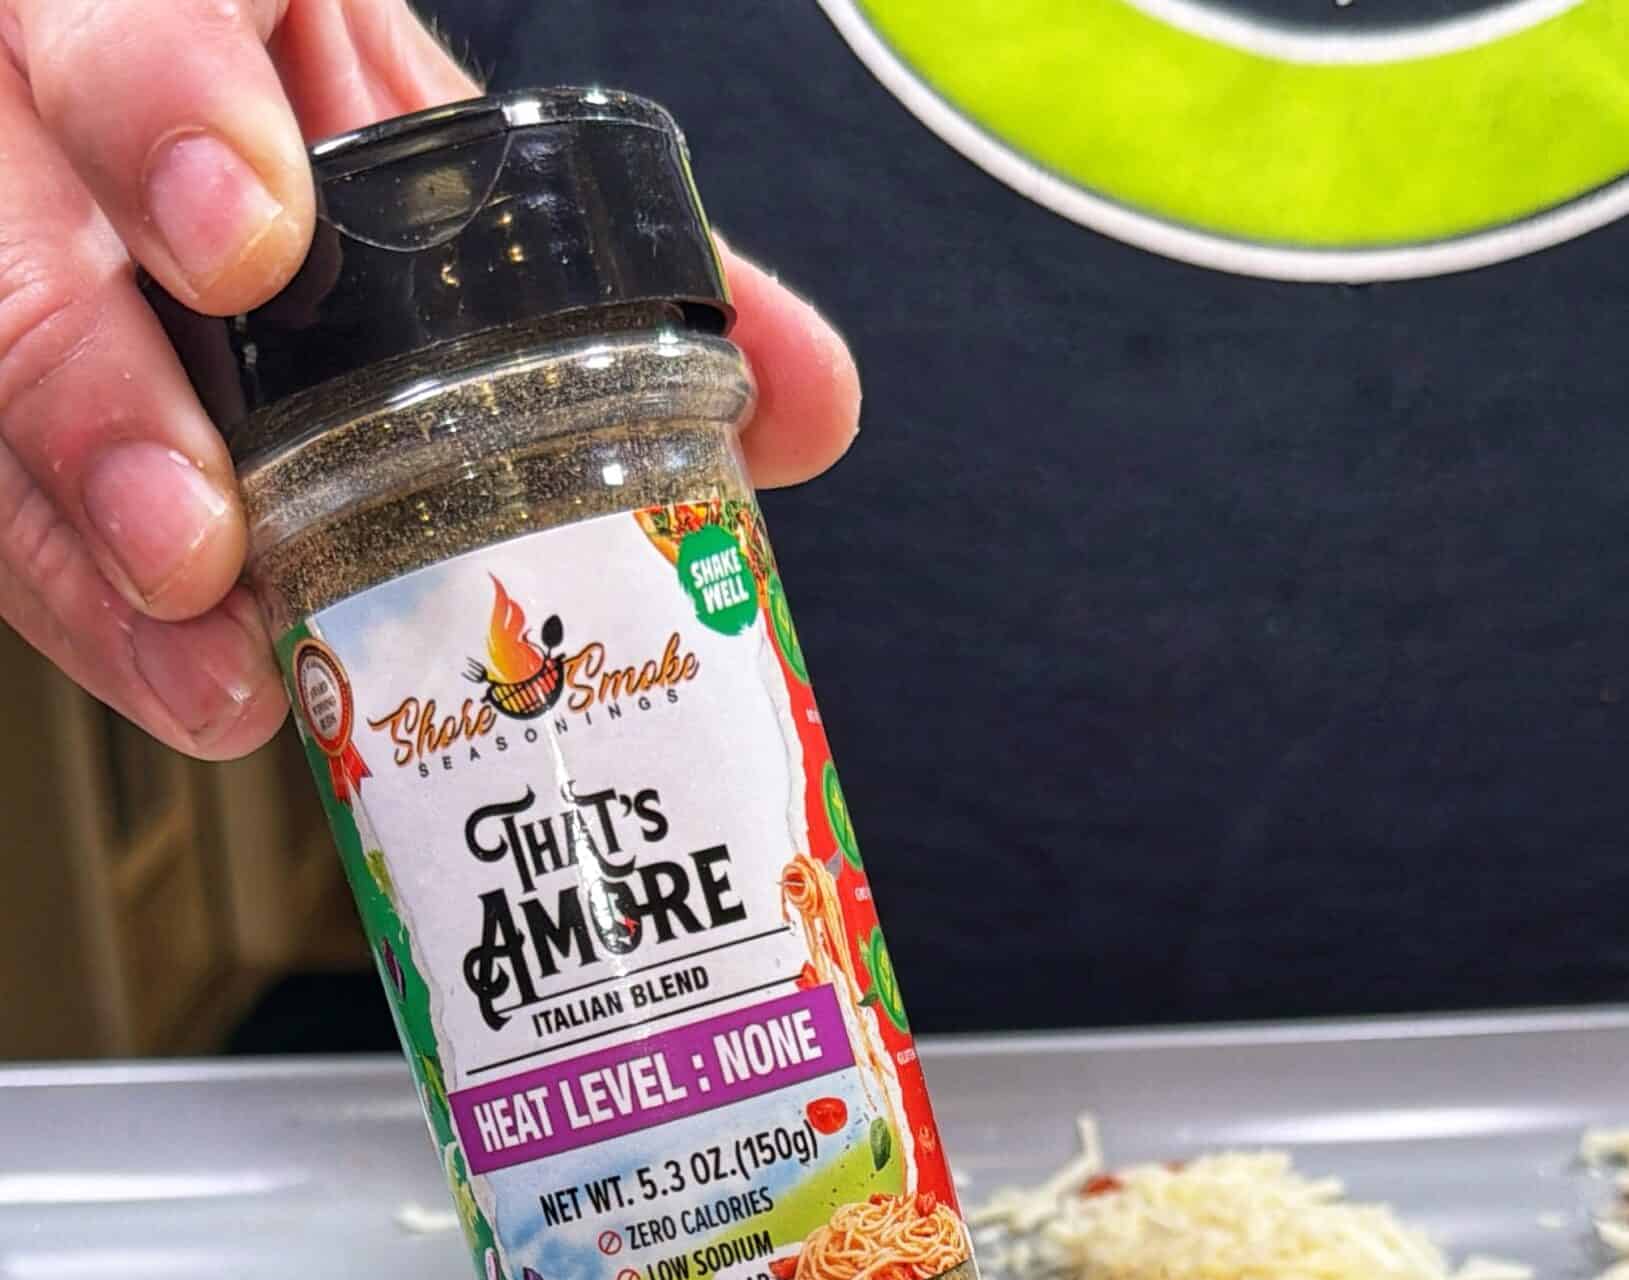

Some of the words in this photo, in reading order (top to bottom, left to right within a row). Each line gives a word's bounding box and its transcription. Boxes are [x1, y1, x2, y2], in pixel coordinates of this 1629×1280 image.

[691, 546, 742, 590] SHAKE
[702, 573, 750, 614] WELL
[366, 695, 497, 767] Shore
[563, 631, 701, 712] Smoke
[418, 687, 679, 779] SEASONINGS
[463, 844, 748, 1032] AMORE
[531, 991, 624, 1038] ITALIAN
[629, 965, 710, 1009] BLEND
[472, 1086, 554, 1153] HEAT
[558, 1051, 688, 1130] LEVEL
[713, 1008, 823, 1085] NONE
[539, 1186, 583, 1227] NET
[585, 1174, 635, 1216] WT.
[637, 1159, 686, 1201] 5.3
[625, 1215, 677, 1251] ZERO
[680, 1185, 774, 1236] CALORIES
[695, 1229, 774, 1275] SODIUM
